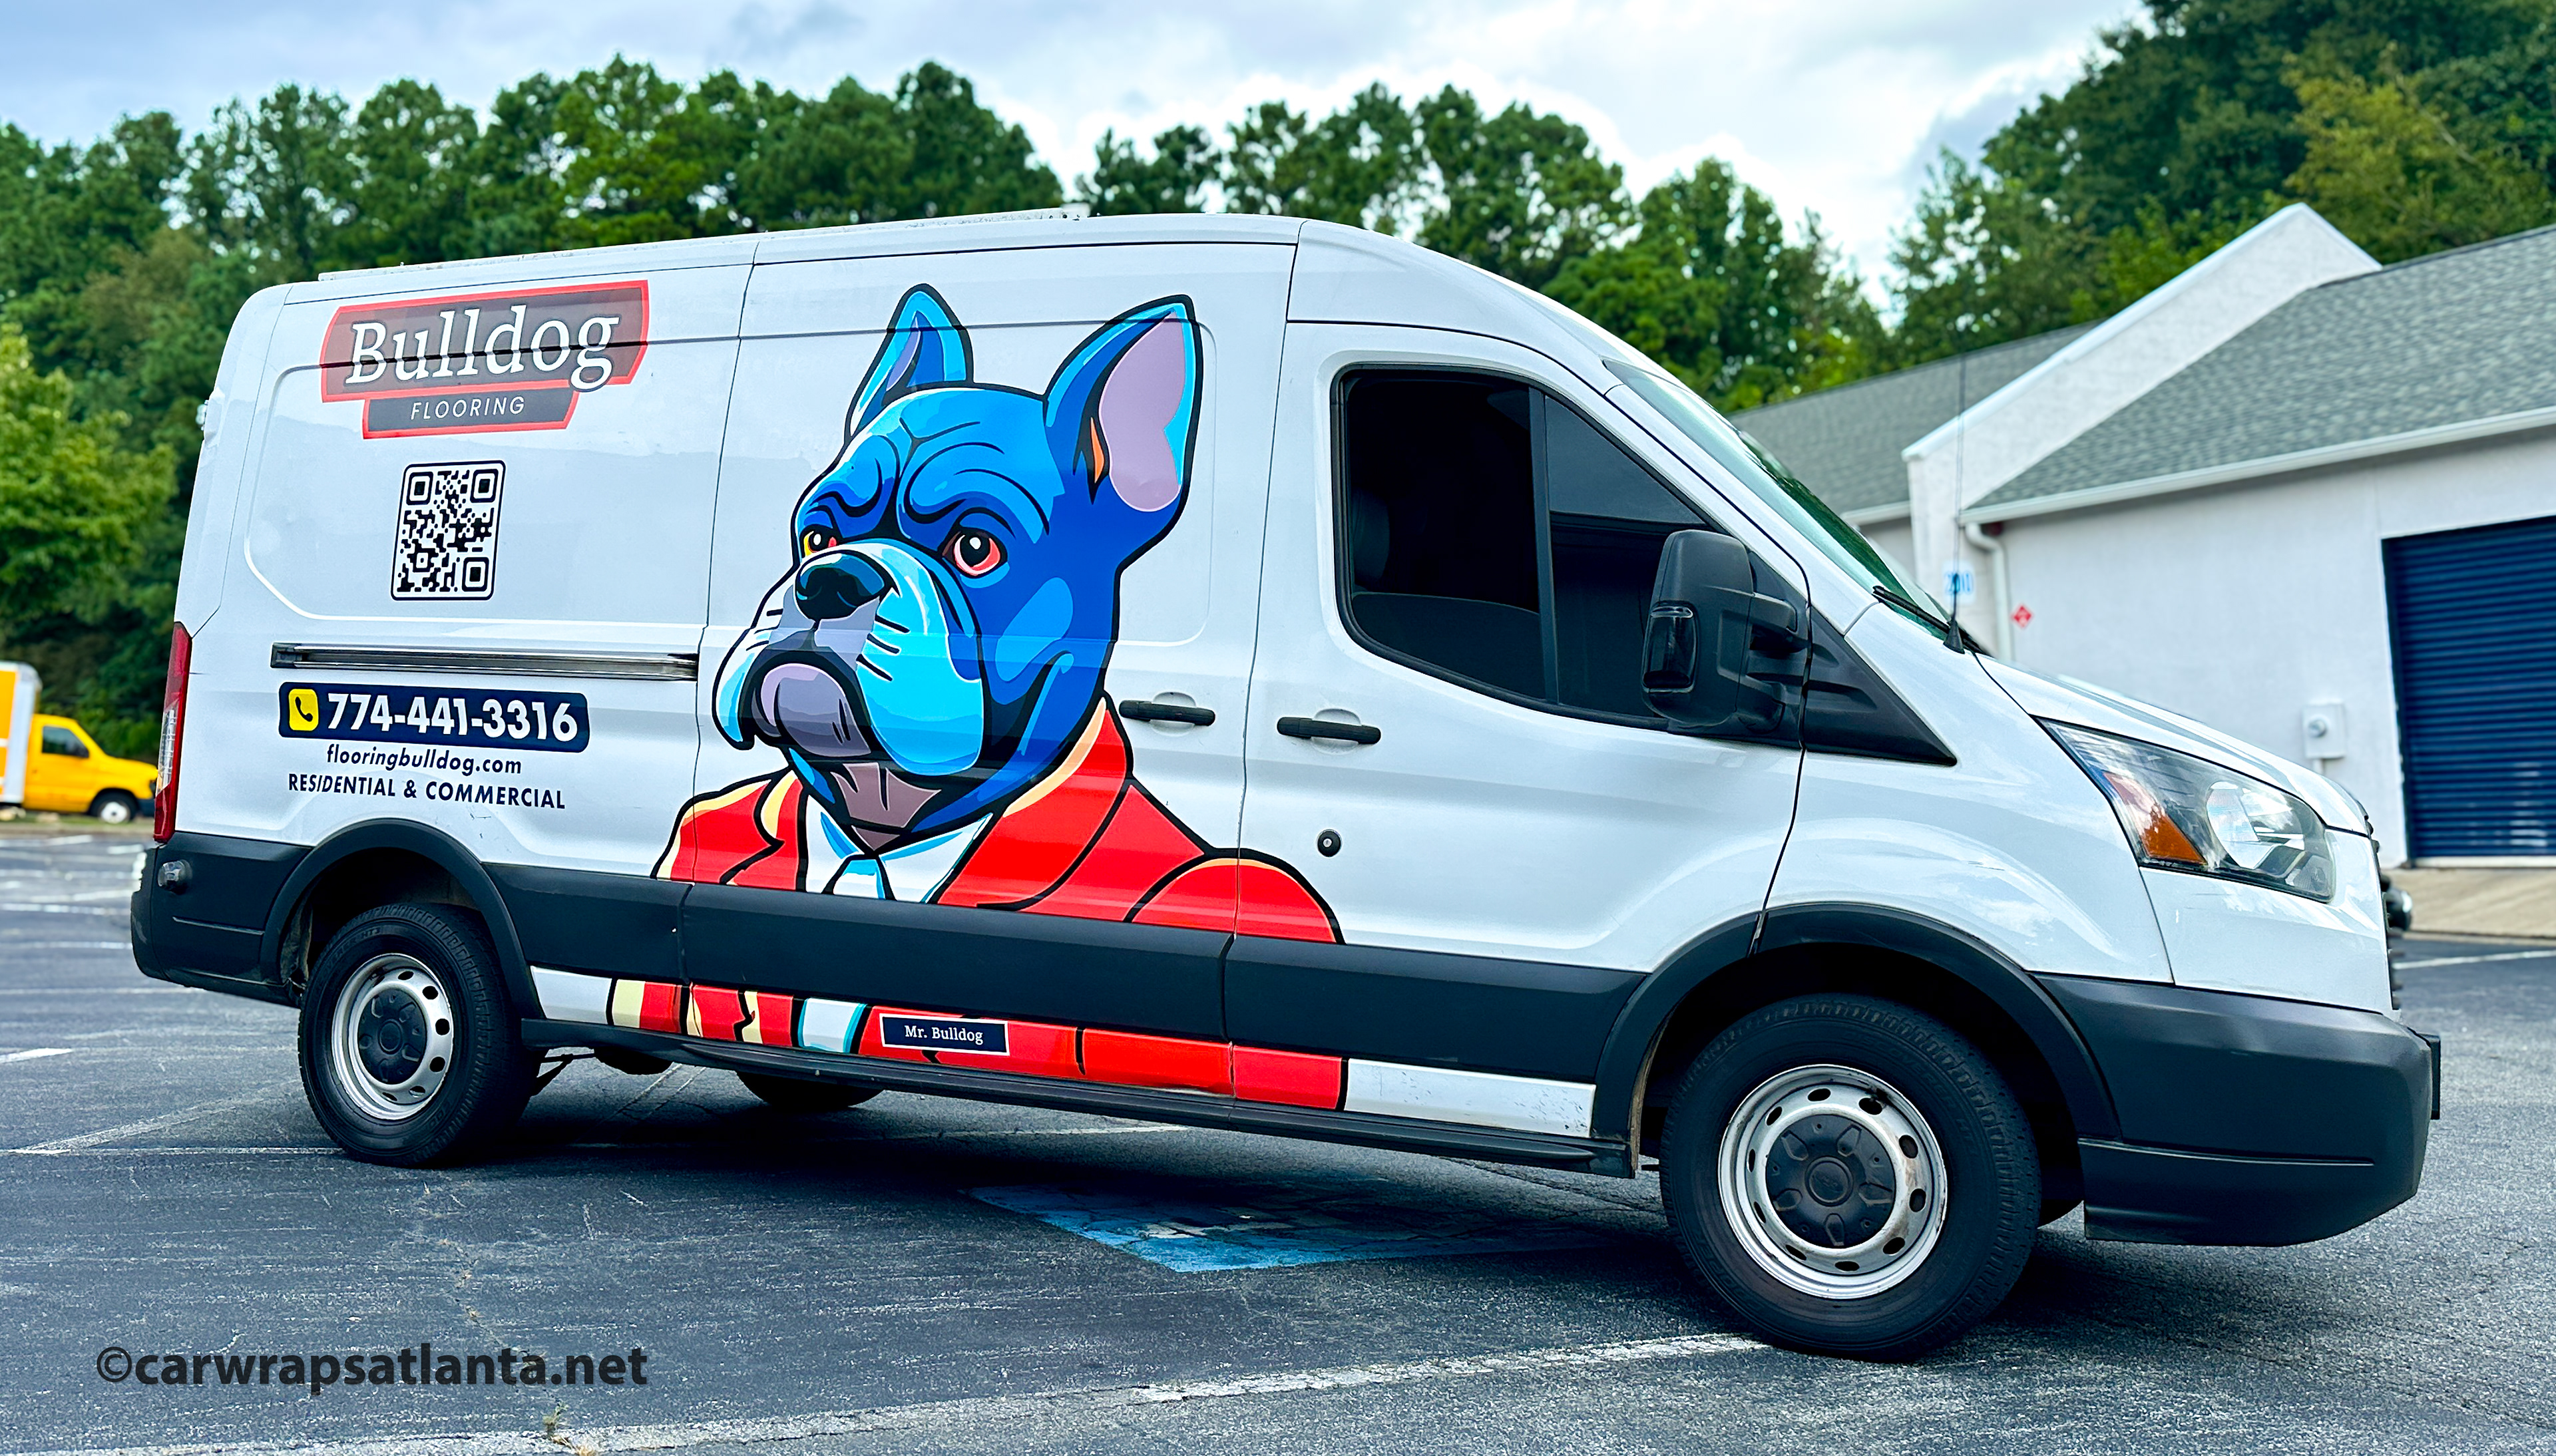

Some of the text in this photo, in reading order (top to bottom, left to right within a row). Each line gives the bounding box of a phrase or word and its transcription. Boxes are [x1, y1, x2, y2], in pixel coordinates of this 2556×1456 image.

[345, 304, 620, 391] Bulldog
[410, 396, 525, 421] FLOORING
[327, 693, 578, 742] 774-441-3316
[327, 743, 522, 777] flooringbulldog.com
[288, 773, 566, 809] RESIDENTIAL & COMMERCIAL
[904, 1025, 984, 1045] Mr. Bulldog
